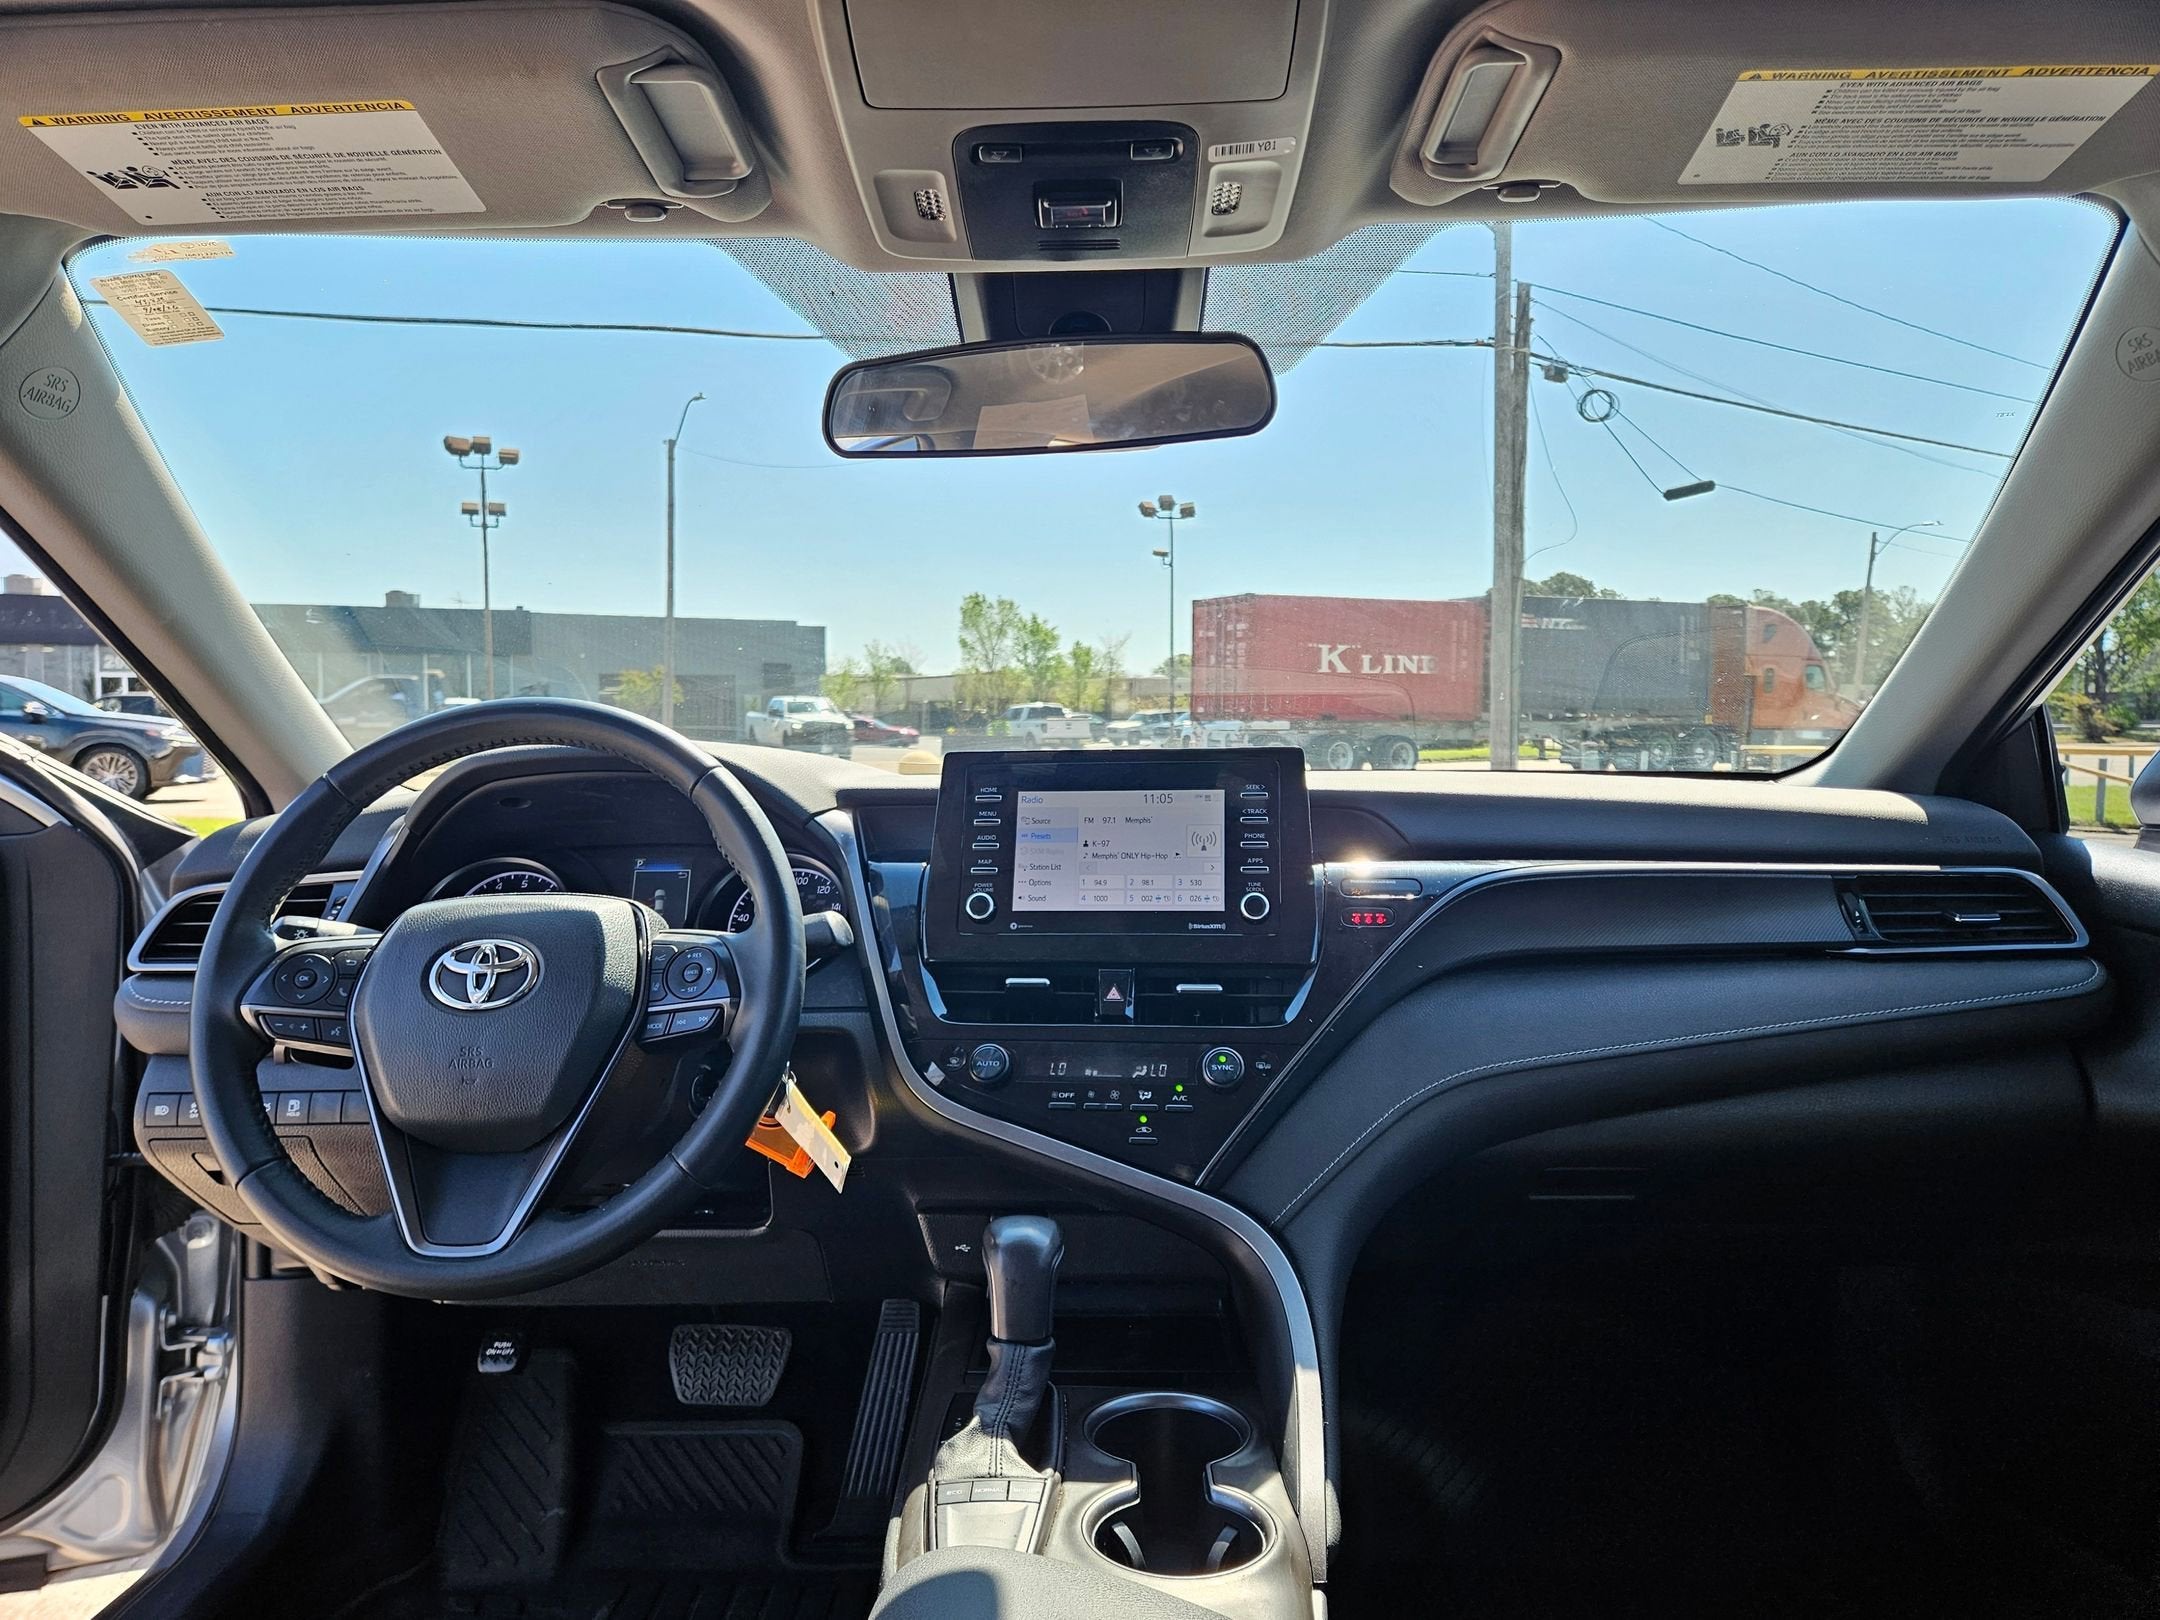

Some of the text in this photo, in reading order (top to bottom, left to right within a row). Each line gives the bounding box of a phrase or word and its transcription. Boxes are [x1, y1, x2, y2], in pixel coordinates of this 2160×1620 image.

[1772, 67, 2150, 80] WARNING AVERTISSEMENT ADVERTENCIA
[49, 102, 405, 126] WARNING AVERTISSEMENT ADVERTENCIA
[183, 120, 228, 128] ADVANCED
[237, 155, 279, 163] COUSSINS
[347, 150, 390, 158] NOUVELLE
[2127, 332, 2153, 354] SRS
[2127, 349, 2160, 375] AIRBA
[43, 373, 69, 393] SRS
[23, 386, 72, 413] AIRBAG
[1361, 655, 1438, 674] LINE
[1021, 793, 1174, 804] Radio 11:05
[1031, 817, 1051, 825] Source
[1140, 852, 1169, 860] Hip-Hop
[637, 860, 644, 868] P
[1029, 863, 1050, 871] Station
[495, 882, 503, 890] 4
[520, 879, 528, 888] 5
[1028, 879, 1052, 887] Options
[817, 886, 831, 895] 120
[737, 913, 750, 922] 40
[299, 974, 310, 982] OK
[460, 1046, 484, 1057] SRS
[448, 1058, 495, 1070] AIRBAG
[493, 1341, 513, 1349] PUSH
